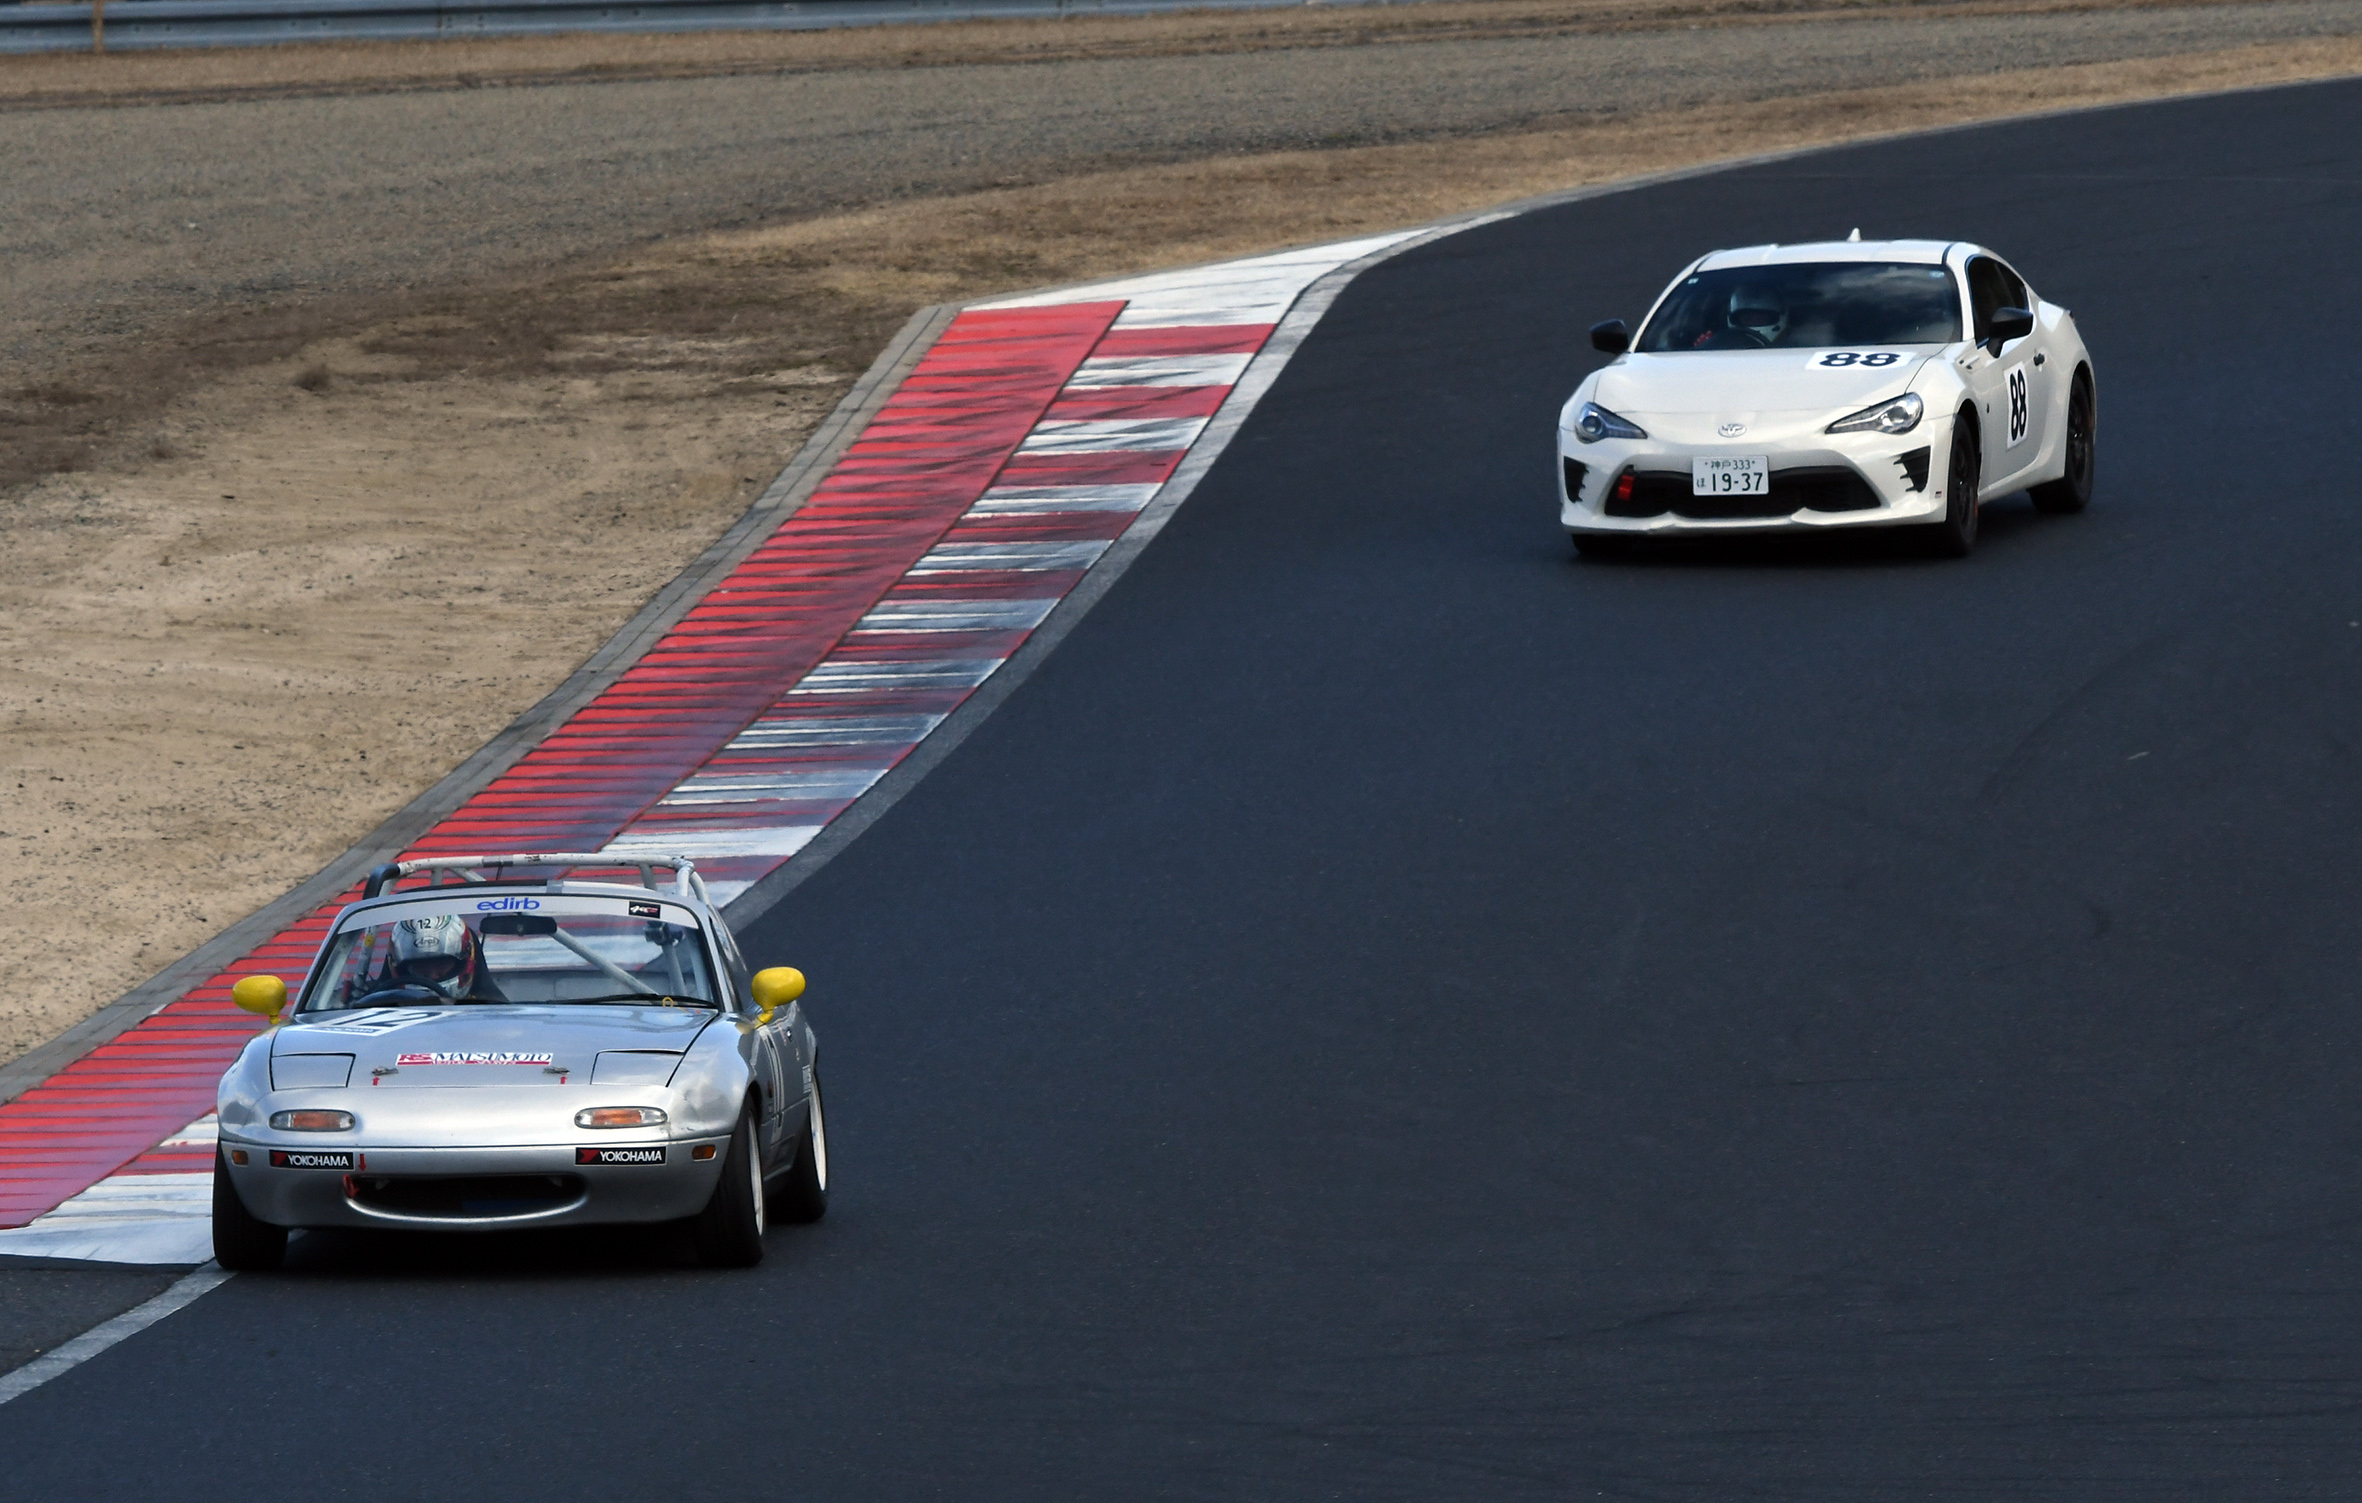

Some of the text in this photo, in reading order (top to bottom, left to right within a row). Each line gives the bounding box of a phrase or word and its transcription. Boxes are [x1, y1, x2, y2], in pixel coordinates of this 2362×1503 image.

[1819, 352, 1901, 367] 88
[2009, 369, 2027, 442] 88
[1733, 460, 1751, 470] 333
[1712, 472, 1763, 492] 19-37
[476, 897, 541, 911] edirb
[332, 1009, 443, 1027] 12
[434, 1053, 552, 1062] MATSUMOTO
[287, 1154, 350, 1167] YOKOHAMA
[600, 1150, 663, 1162] YOKOHAMA
